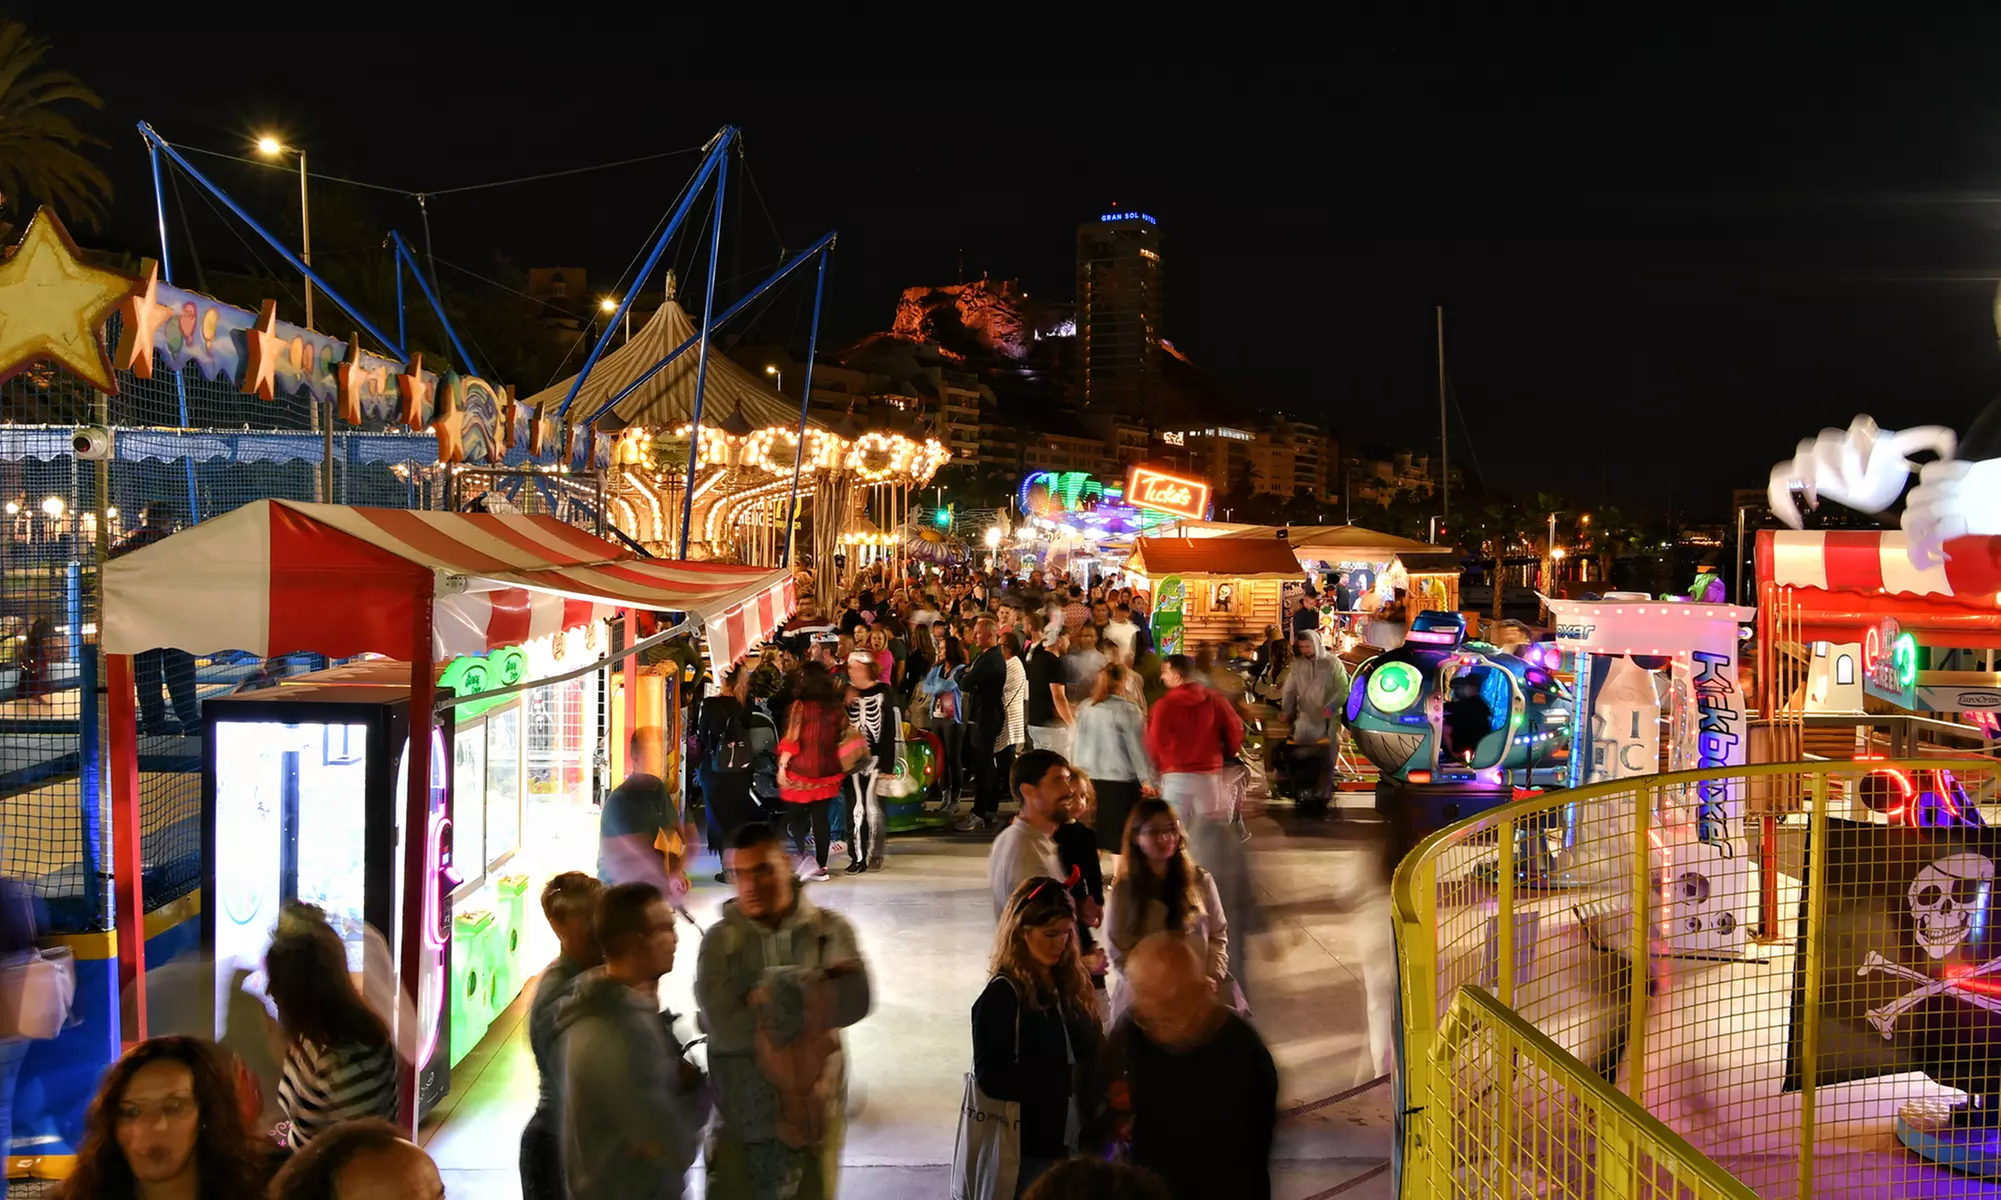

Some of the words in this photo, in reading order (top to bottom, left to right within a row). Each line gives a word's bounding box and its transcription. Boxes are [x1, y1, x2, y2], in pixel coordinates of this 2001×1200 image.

[1101, 214, 1122, 222] GRAN
[1124, 212, 1139, 220] SOL
[1141, 476, 1192, 506] Tickets
